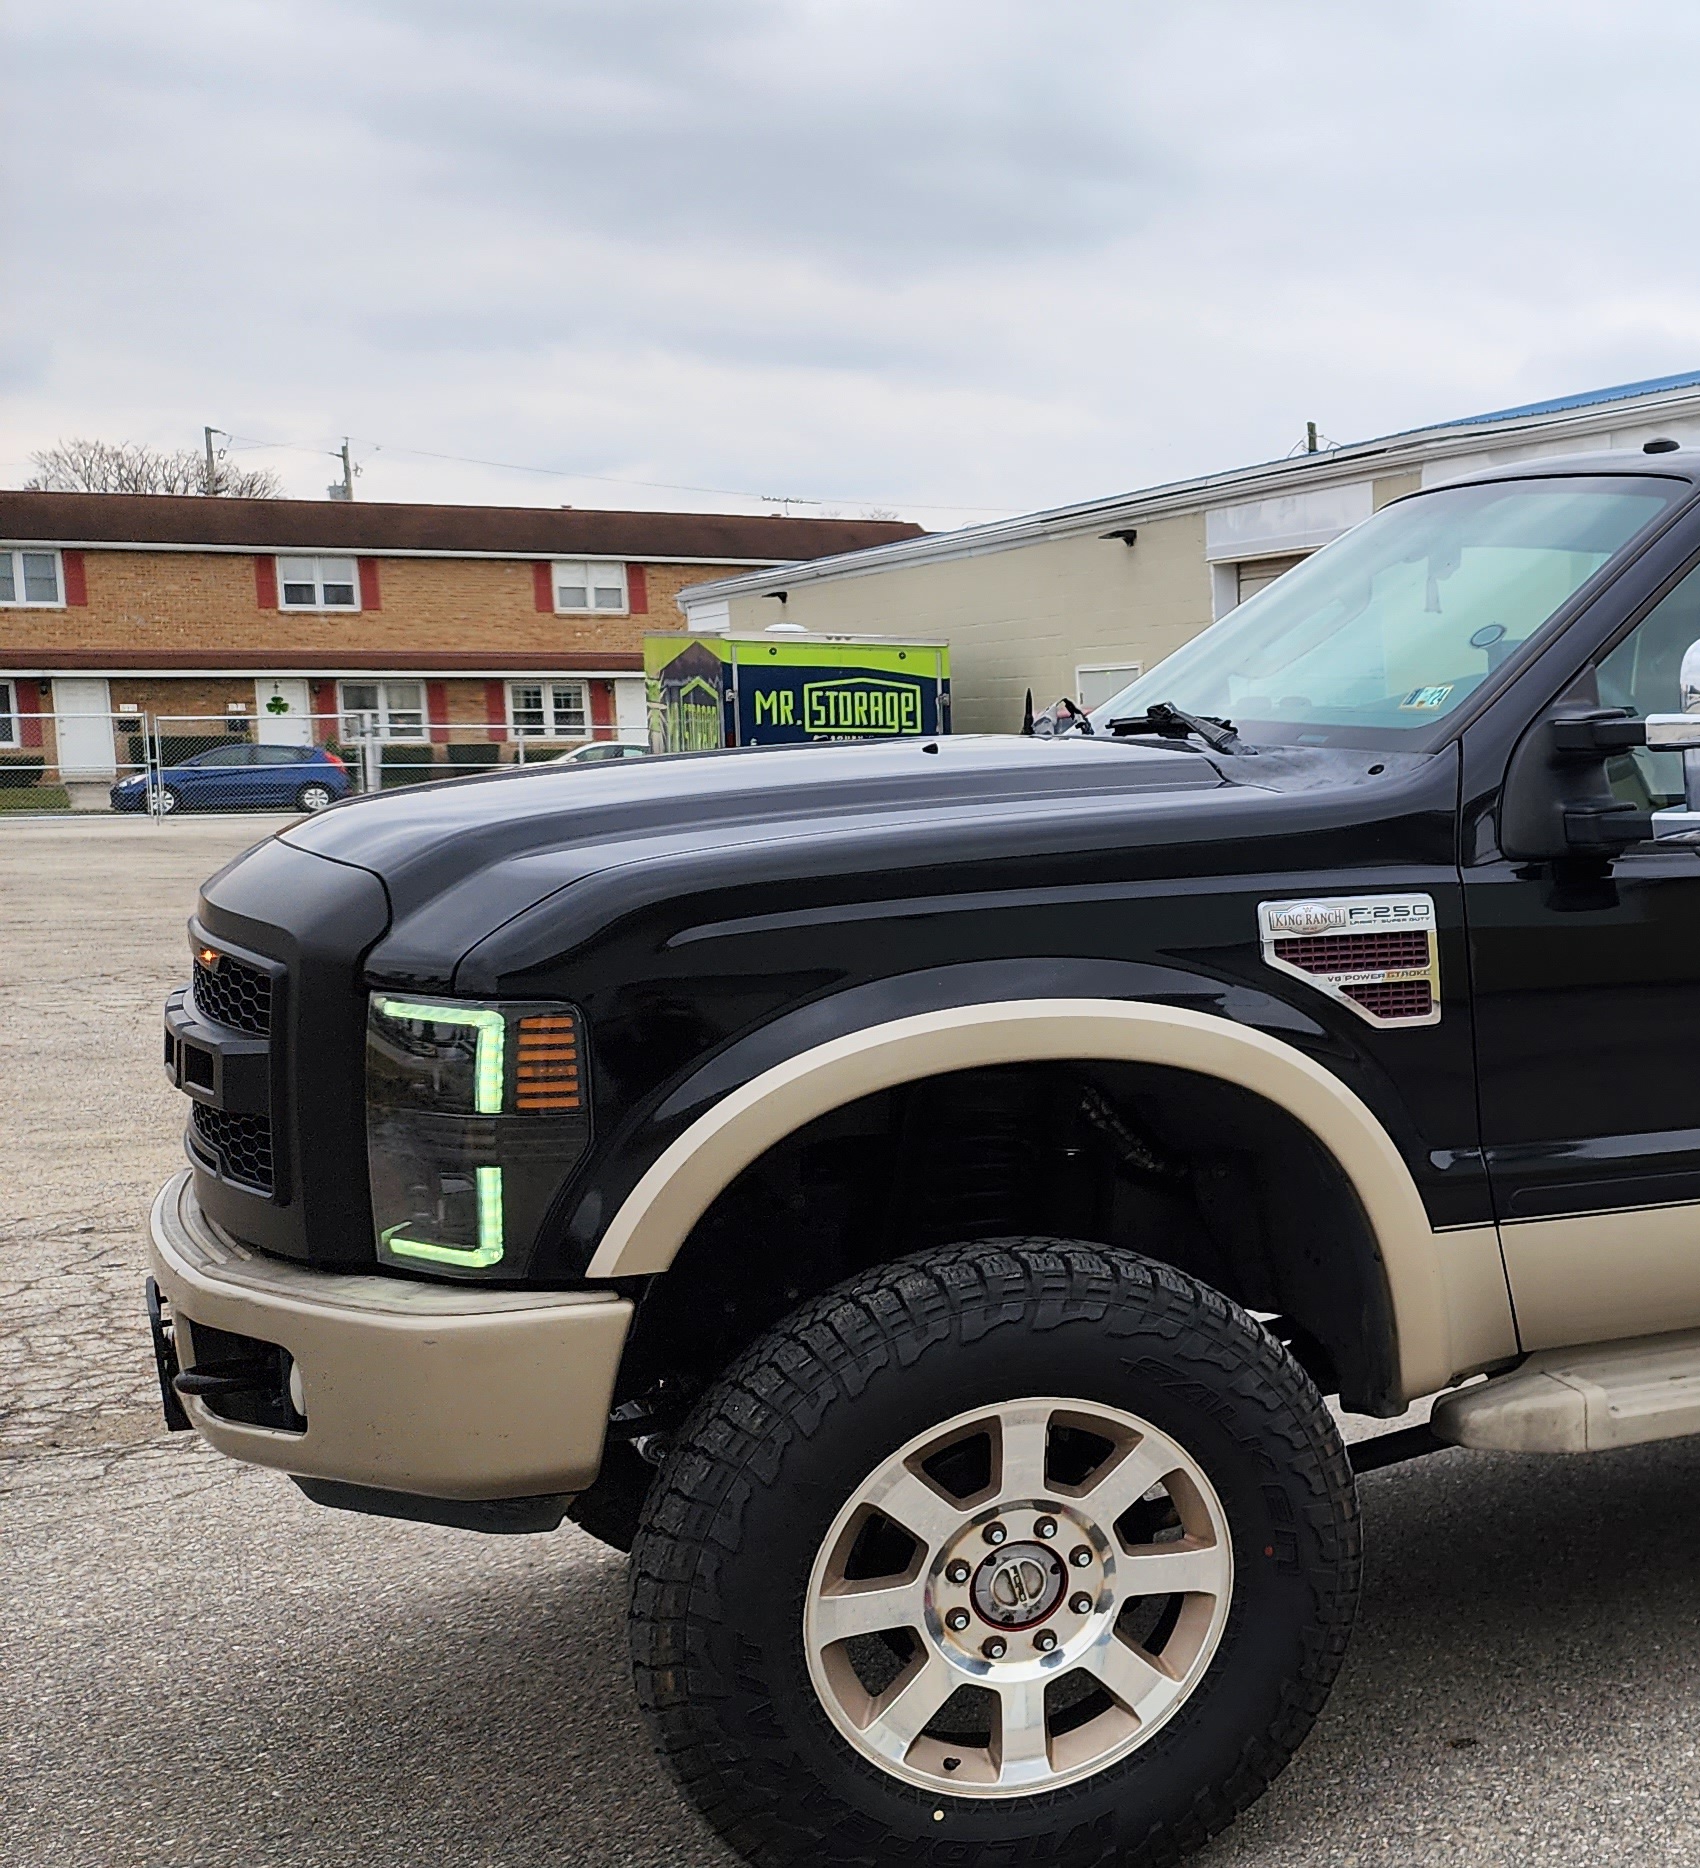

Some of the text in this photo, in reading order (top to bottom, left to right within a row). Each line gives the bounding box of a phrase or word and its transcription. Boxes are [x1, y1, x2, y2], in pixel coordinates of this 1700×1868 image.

[755, 690, 803, 726] MR.
[1275, 909, 1343, 929] KING RANCH
